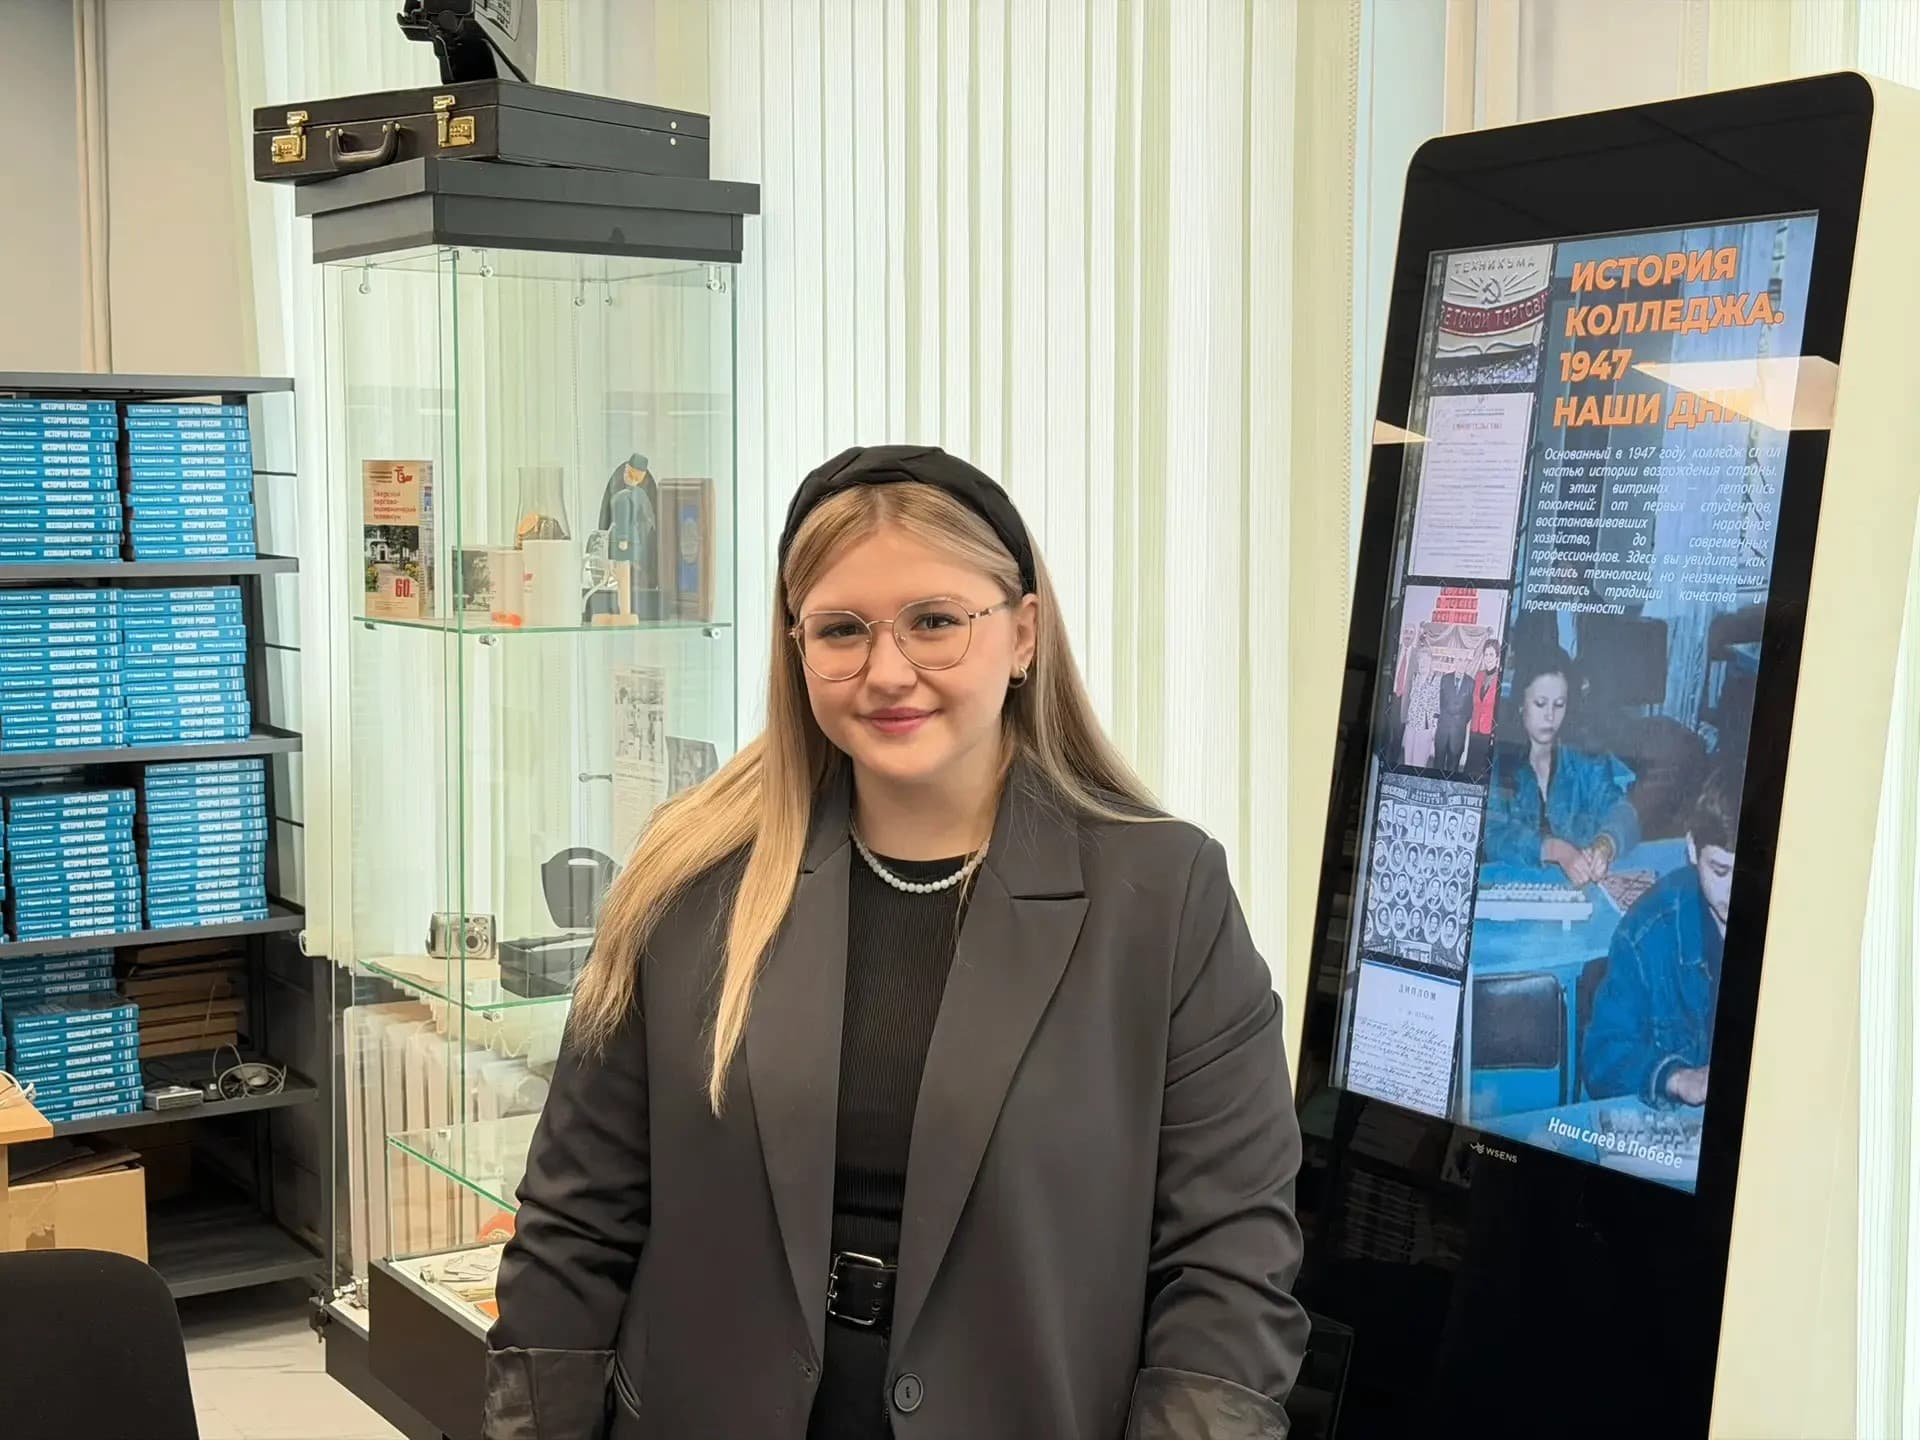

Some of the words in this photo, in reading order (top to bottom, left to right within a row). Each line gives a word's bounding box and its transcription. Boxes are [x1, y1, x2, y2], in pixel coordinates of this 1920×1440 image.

[1570, 247, 1738, 293] ИСТОРИЯ
[1564, 291, 1785, 337] КОЛЛЕДЖА.
[1560, 348, 1633, 382] 1947
[1553, 392, 1661, 428] НАШИ
[1544, 446, 1612, 460] Основанный
[1616, 449, 1623, 460] в
[1628, 446, 1656, 460] 1947
[1659, 445, 1687, 462] году,
[1692, 445, 1745, 459] колледж
[1543, 466, 1584, 477] частью
[1589, 466, 1638, 480] истории
[1643, 464, 1720, 480] возрождения
[1726, 465, 1777, 480] страны.
[1540, 481, 1554, 493] На
[1568, 483, 1597, 494] этих
[1612, 483, 1669, 497] витринах
[1537, 498, 1596, 511] поколений:
[1611, 500, 1628, 511] от
[1643, 501, 1685, 514] первых
[1700, 499, 1772, 516] студентов,
[1536, 517, 1648, 529] восстанавливавших
[1712, 517, 1771, 532] народное
[1533, 531, 1591, 546] хозяйство,
[1632, 532, 1647, 546] до
[1689, 536, 1768, 551] современных
[1531, 548, 1620, 564] профессионалов.
[1626, 550, 1657, 564] Здесь
[1663, 553, 1679, 564] вы
[1682, 552, 1738, 568] увидите,
[1745, 556, 1768, 567] как
[1529, 566, 1578, 578] менялись
[1584, 568, 1653, 583] технологии,
[1660, 571, 1675, 582] но
[1681, 572, 1765, 586] неизменными
[395, 578, 411, 598] 60
[1527, 583, 1590, 596] оставались
[1605, 584, 1663, 601] традиции
[1680, 590, 1737, 603] качества
[1753, 593, 1761, 604] и
[1525, 599, 1626, 615] преемственности
[1548, 1116, 1580, 1140] Наш
[1581, 1128, 1616, 1153] след
[1617, 1140, 1626, 1153] в
[1627, 1140, 1683, 1169] Победе
[1485, 1146, 1518, 1164] WSENS
